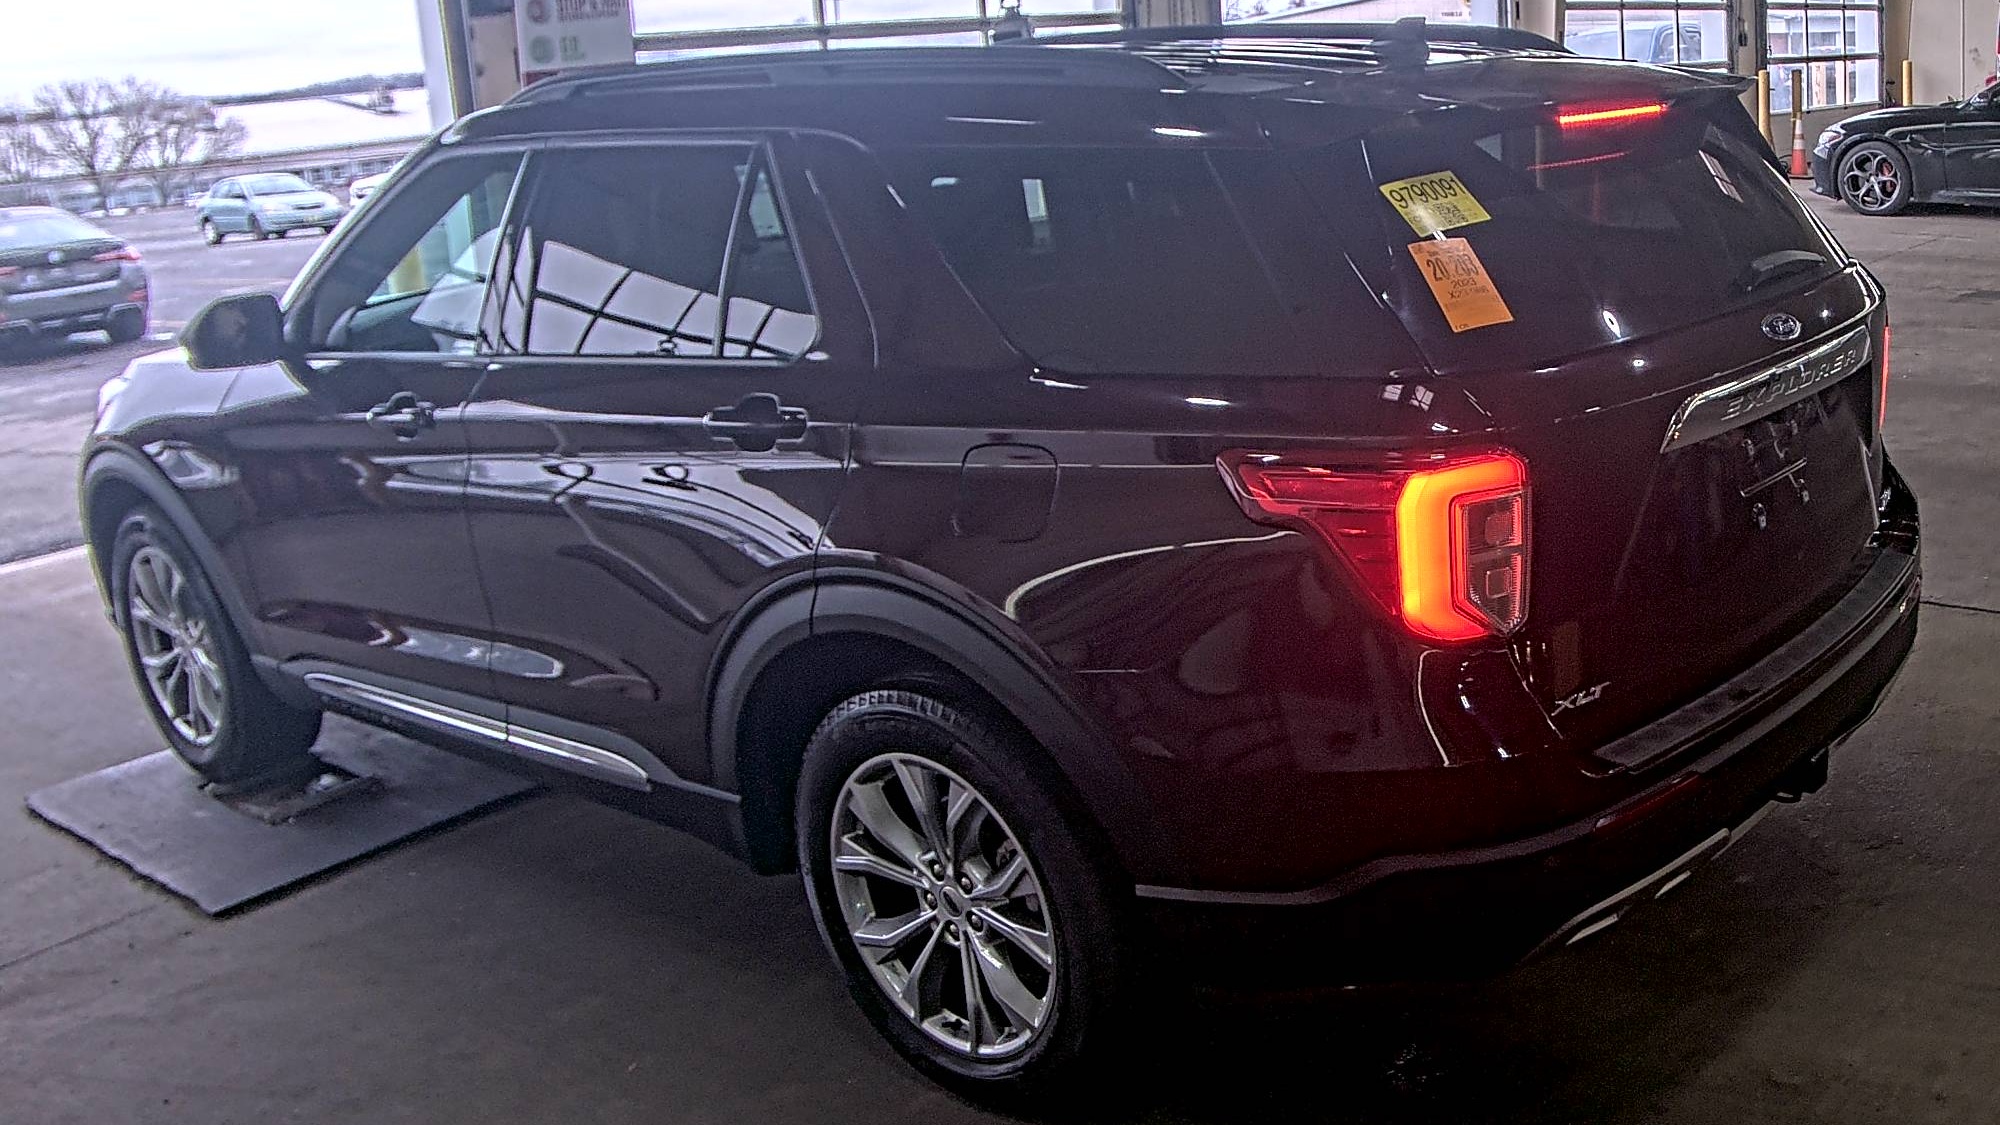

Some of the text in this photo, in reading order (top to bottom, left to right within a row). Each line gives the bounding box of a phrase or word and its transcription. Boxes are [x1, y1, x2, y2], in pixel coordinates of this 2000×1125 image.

[1389, 177, 1466, 209] 9790091
[1720, 349, 1857, 421] EXPLORER
[1551, 681, 1611, 716] XLT
